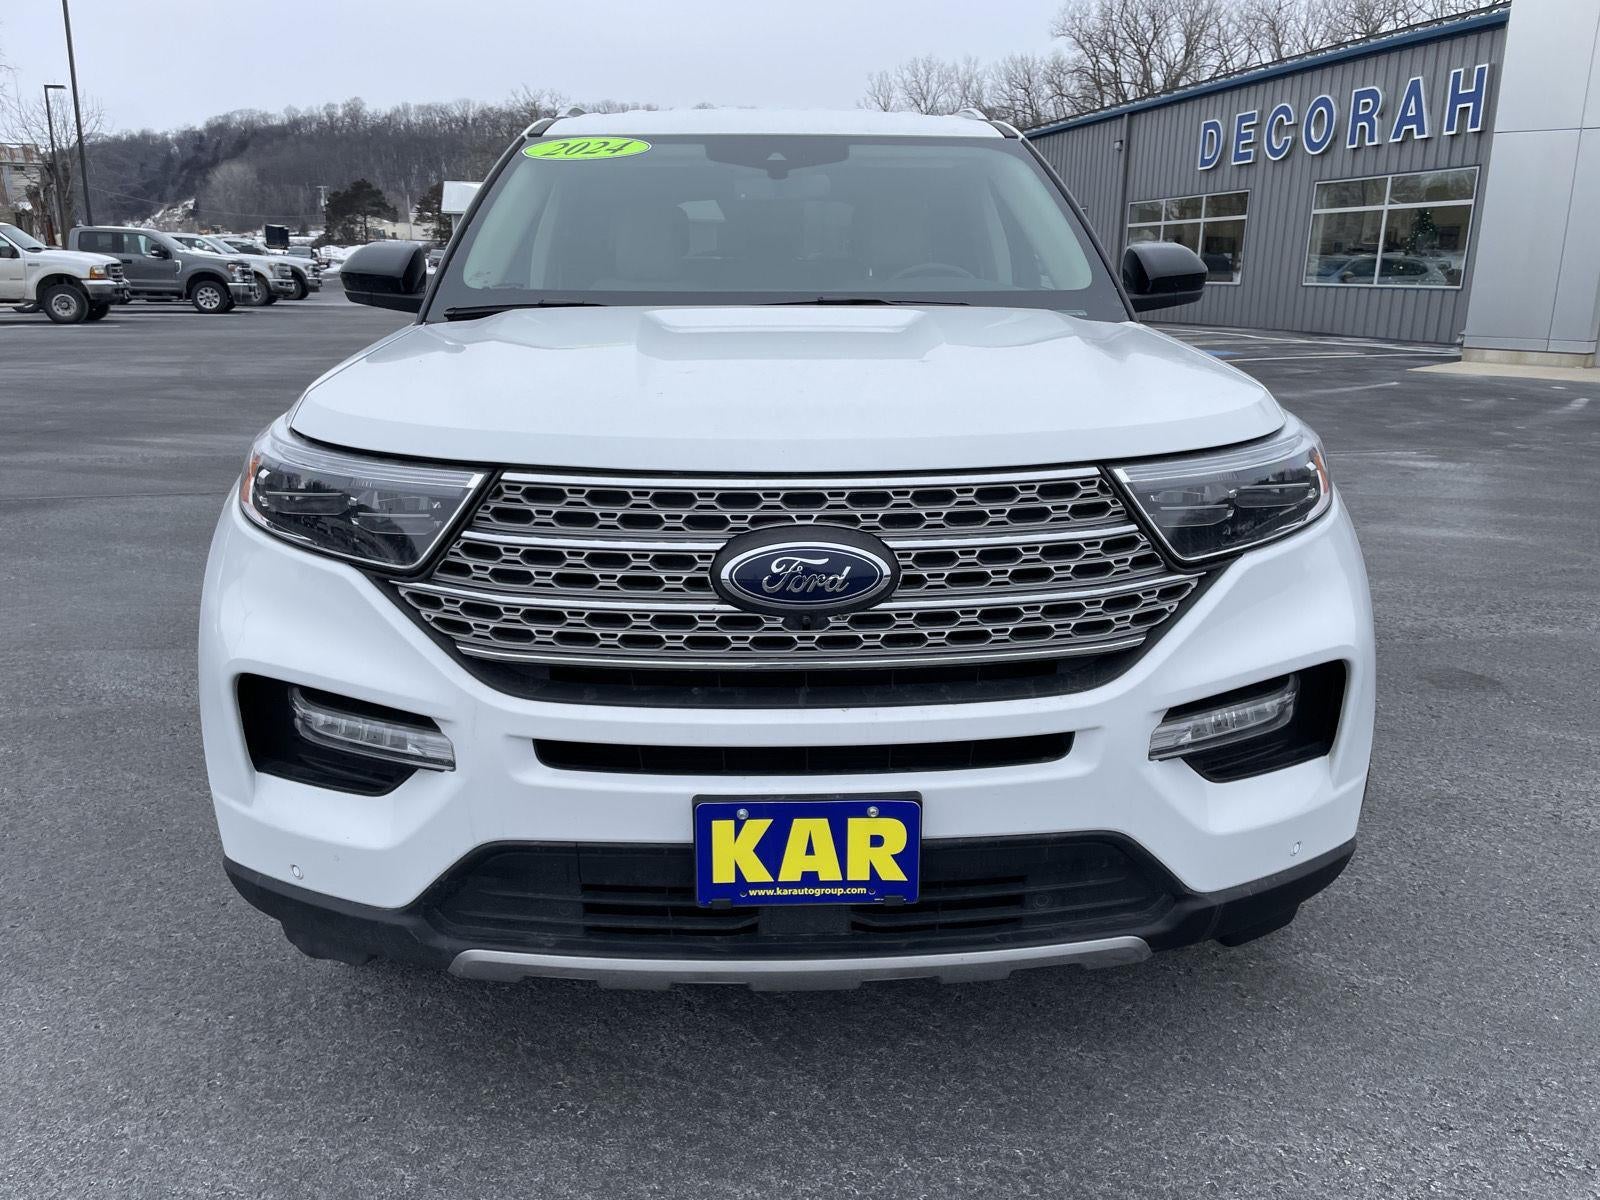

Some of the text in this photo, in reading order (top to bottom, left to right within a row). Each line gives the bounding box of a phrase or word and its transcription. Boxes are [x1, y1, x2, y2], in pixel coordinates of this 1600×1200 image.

[1197, 63, 1490, 171] DECORAH
[540, 141, 634, 156] 2024
[761, 556, 851, 593] Ford
[711, 817, 908, 884] KAR
[748, 887, 867, 897] www.karautogroup.com
